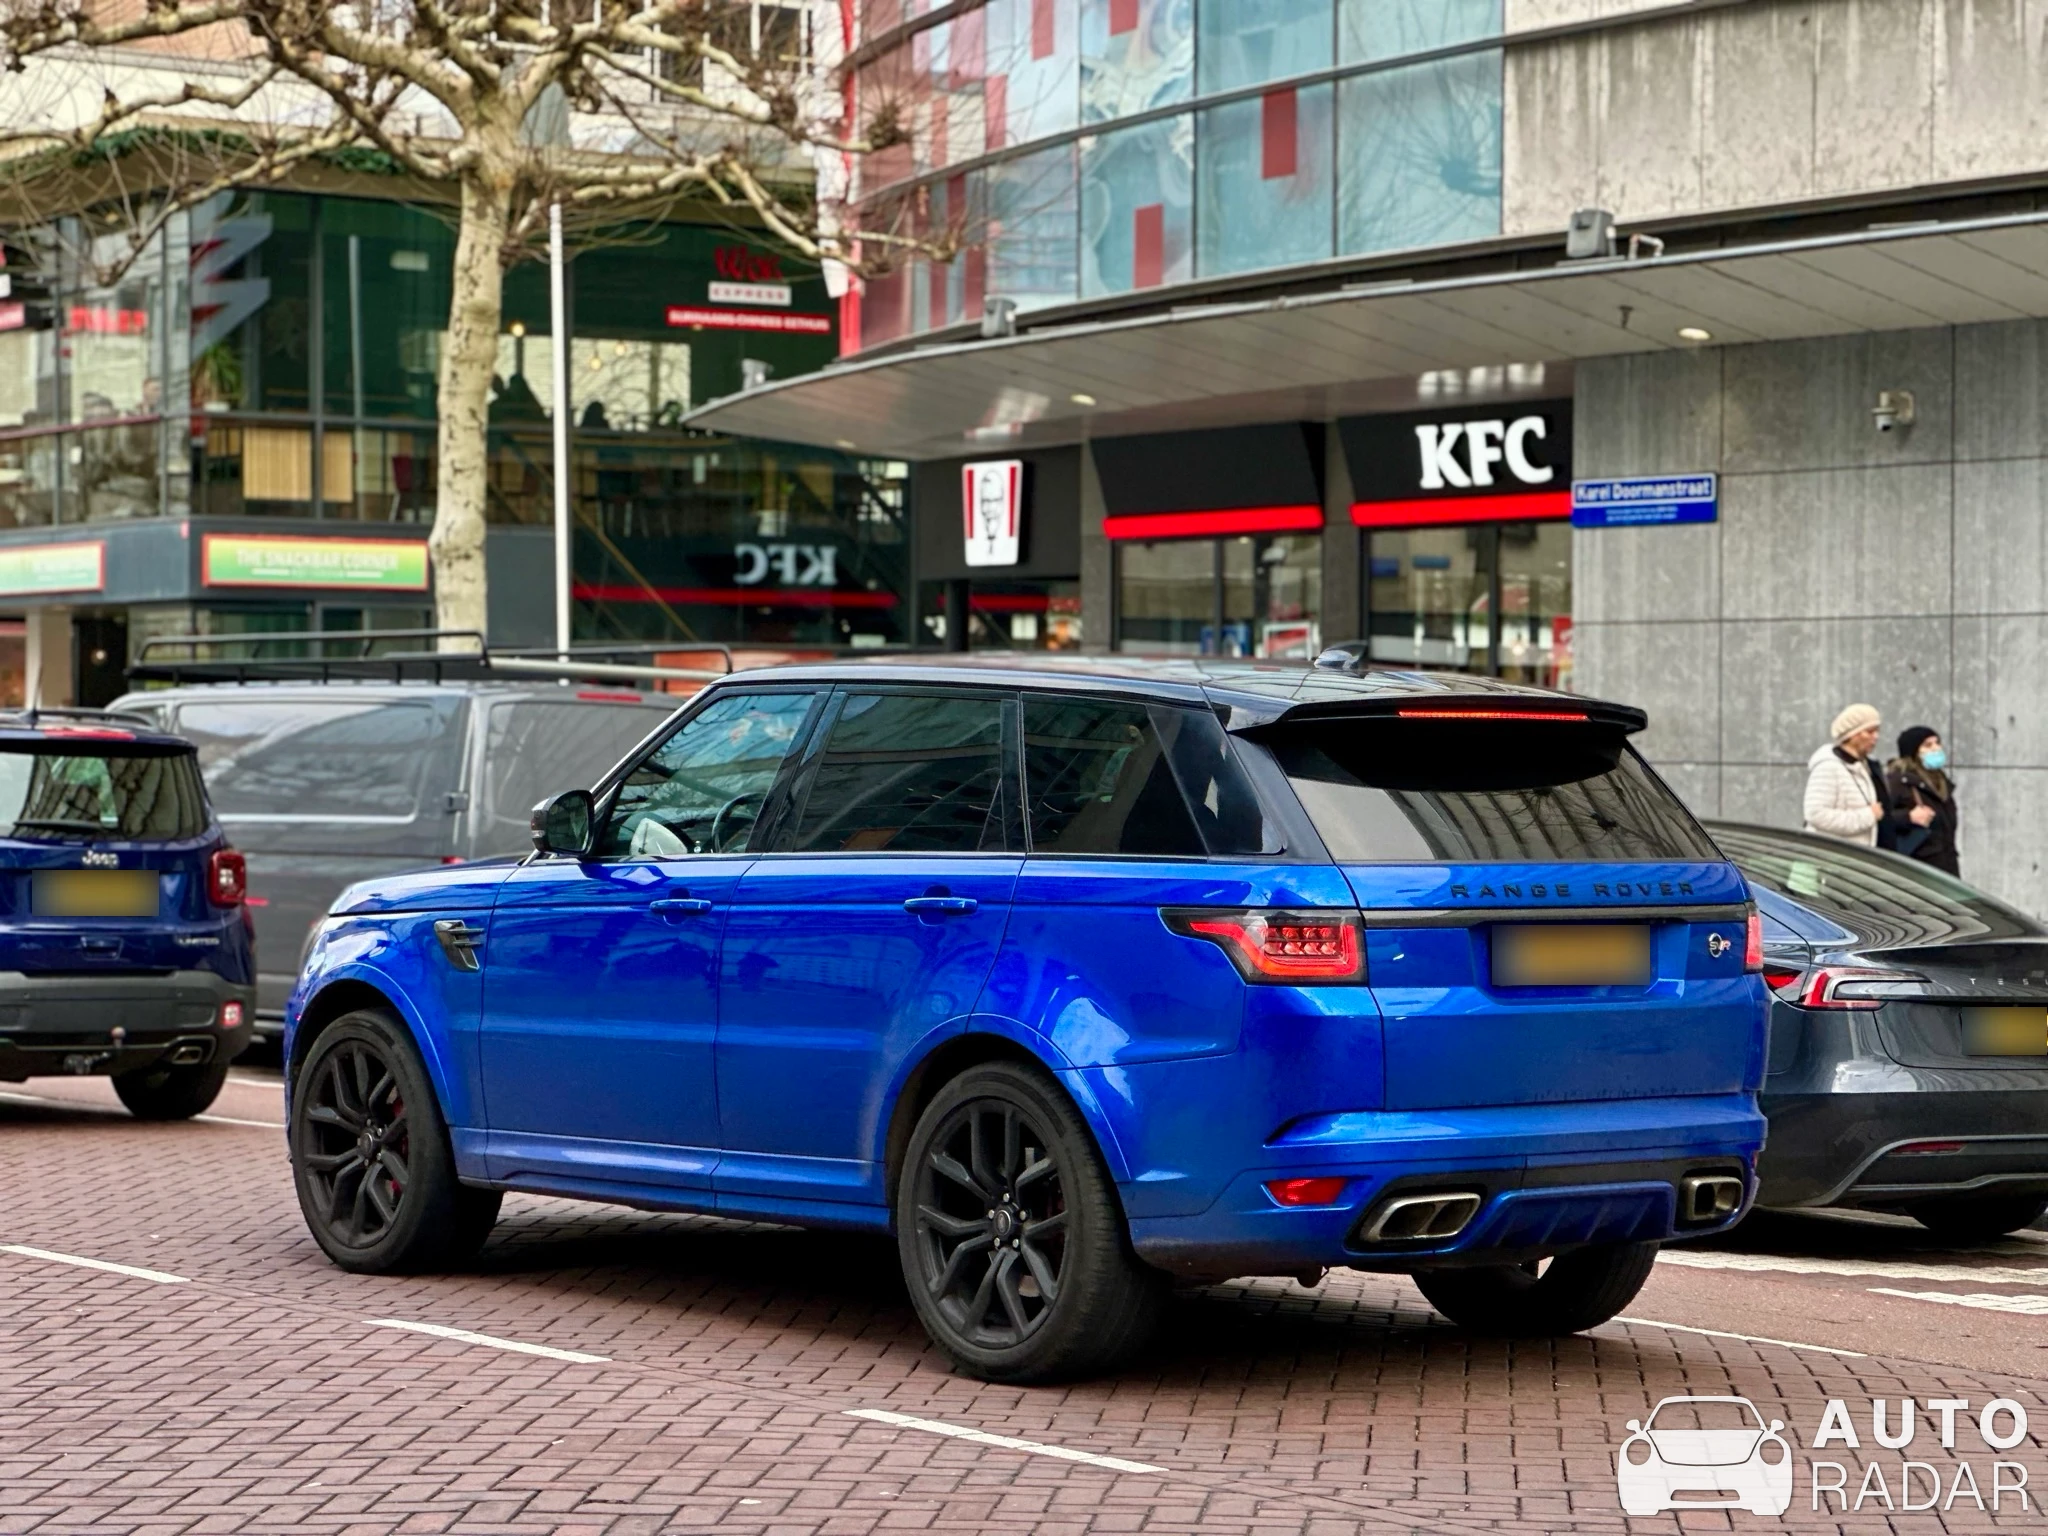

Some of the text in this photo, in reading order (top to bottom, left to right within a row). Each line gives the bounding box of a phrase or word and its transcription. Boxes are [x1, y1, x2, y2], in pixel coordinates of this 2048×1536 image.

[712, 286, 785, 300] EXPRESS
[1414, 415, 1554, 490] KFC
[1577, 479, 1710, 501] Karel Doormanstraat
[236, 548, 263, 568] THE
[265, 550, 342, 569] SNACKBAR
[82, 850, 119, 868] Jeep
[1450, 882, 1695, 899] RANGE ROVER
